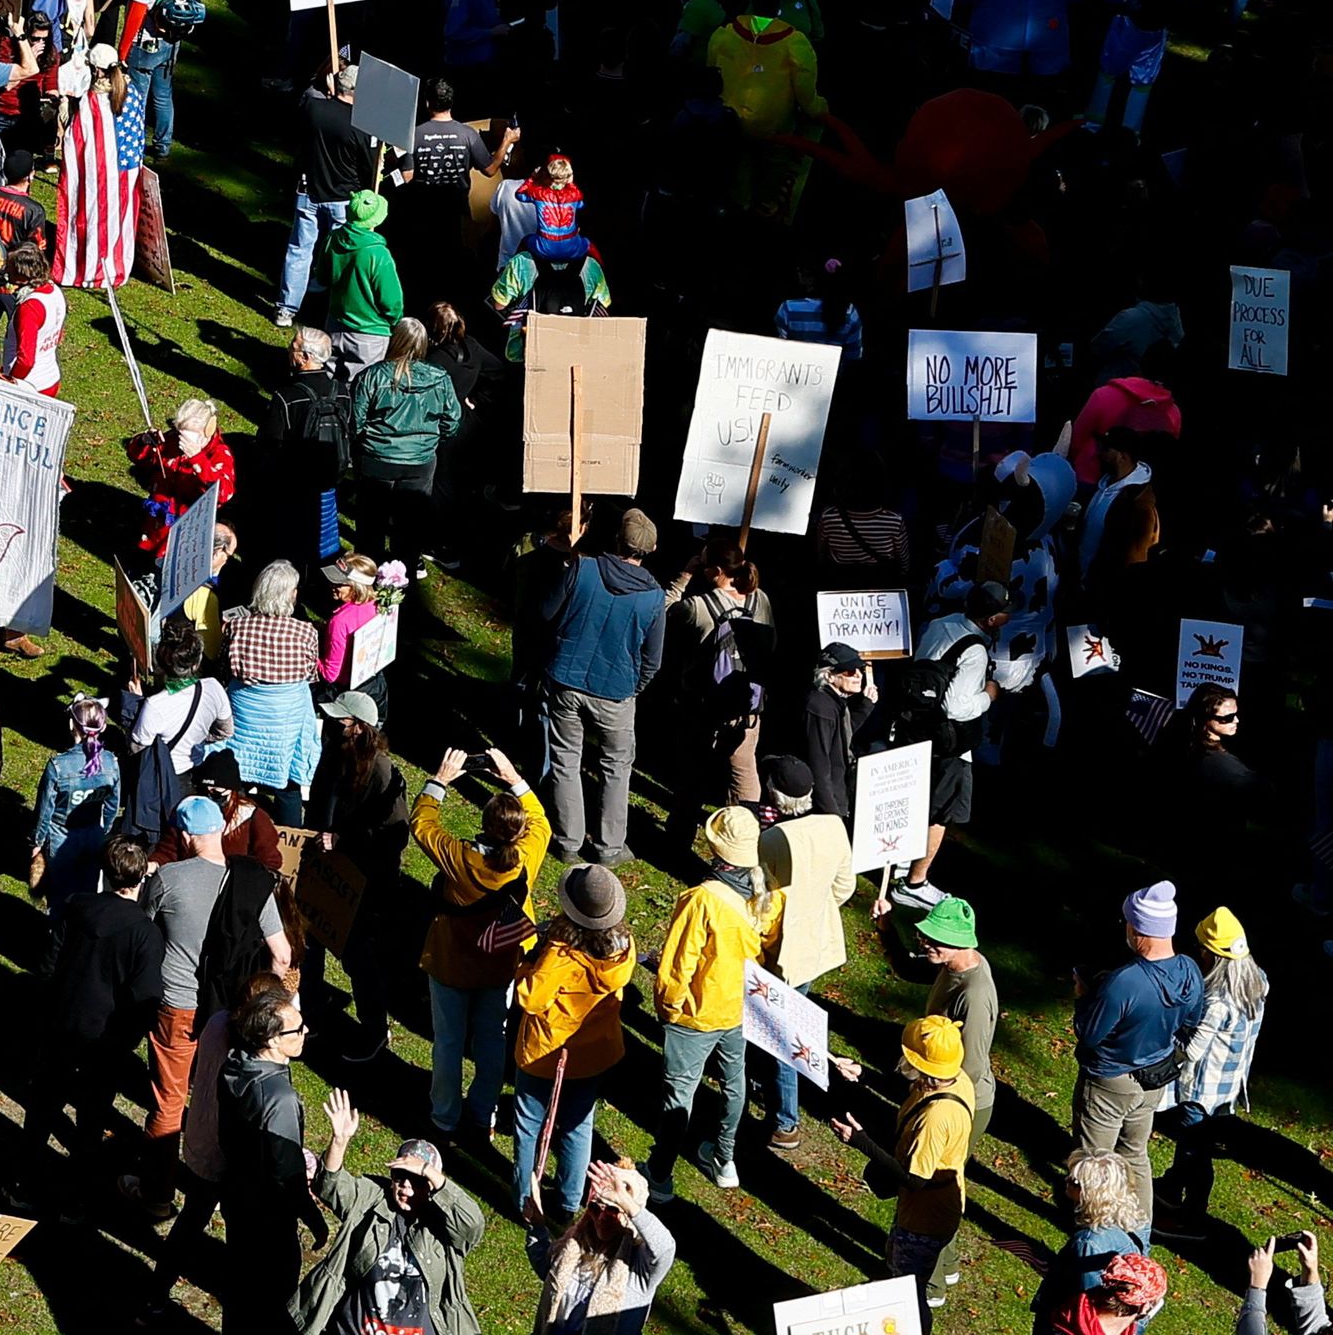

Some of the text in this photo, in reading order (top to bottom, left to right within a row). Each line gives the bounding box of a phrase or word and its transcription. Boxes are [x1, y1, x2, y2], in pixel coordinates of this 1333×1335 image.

[1243, 273, 1276, 299] DUE
[1233, 301, 1286, 327] PROCESS
[1243, 328, 1268, 346] FOR
[1239, 346, 1271, 369] ALL
[713, 353, 825, 386] IMMIGRANTS
[926, 354, 1019, 389] NO MORE
[735, 387, 793, 413] FEED
[925, 385, 1019, 417] BULLSHIT
[716, 417, 758, 448] US!
[839, 594, 888, 609] UNITE
[832, 607, 892, 621] AGAINST
[827, 621, 901, 638] TYRANNY!
[1184, 660, 1200, 670] NO
[1181, 671, 1235, 686] NO TRUMP
[874, 802, 885, 814] NO
[872, 816, 909, 835] NO KINGS
